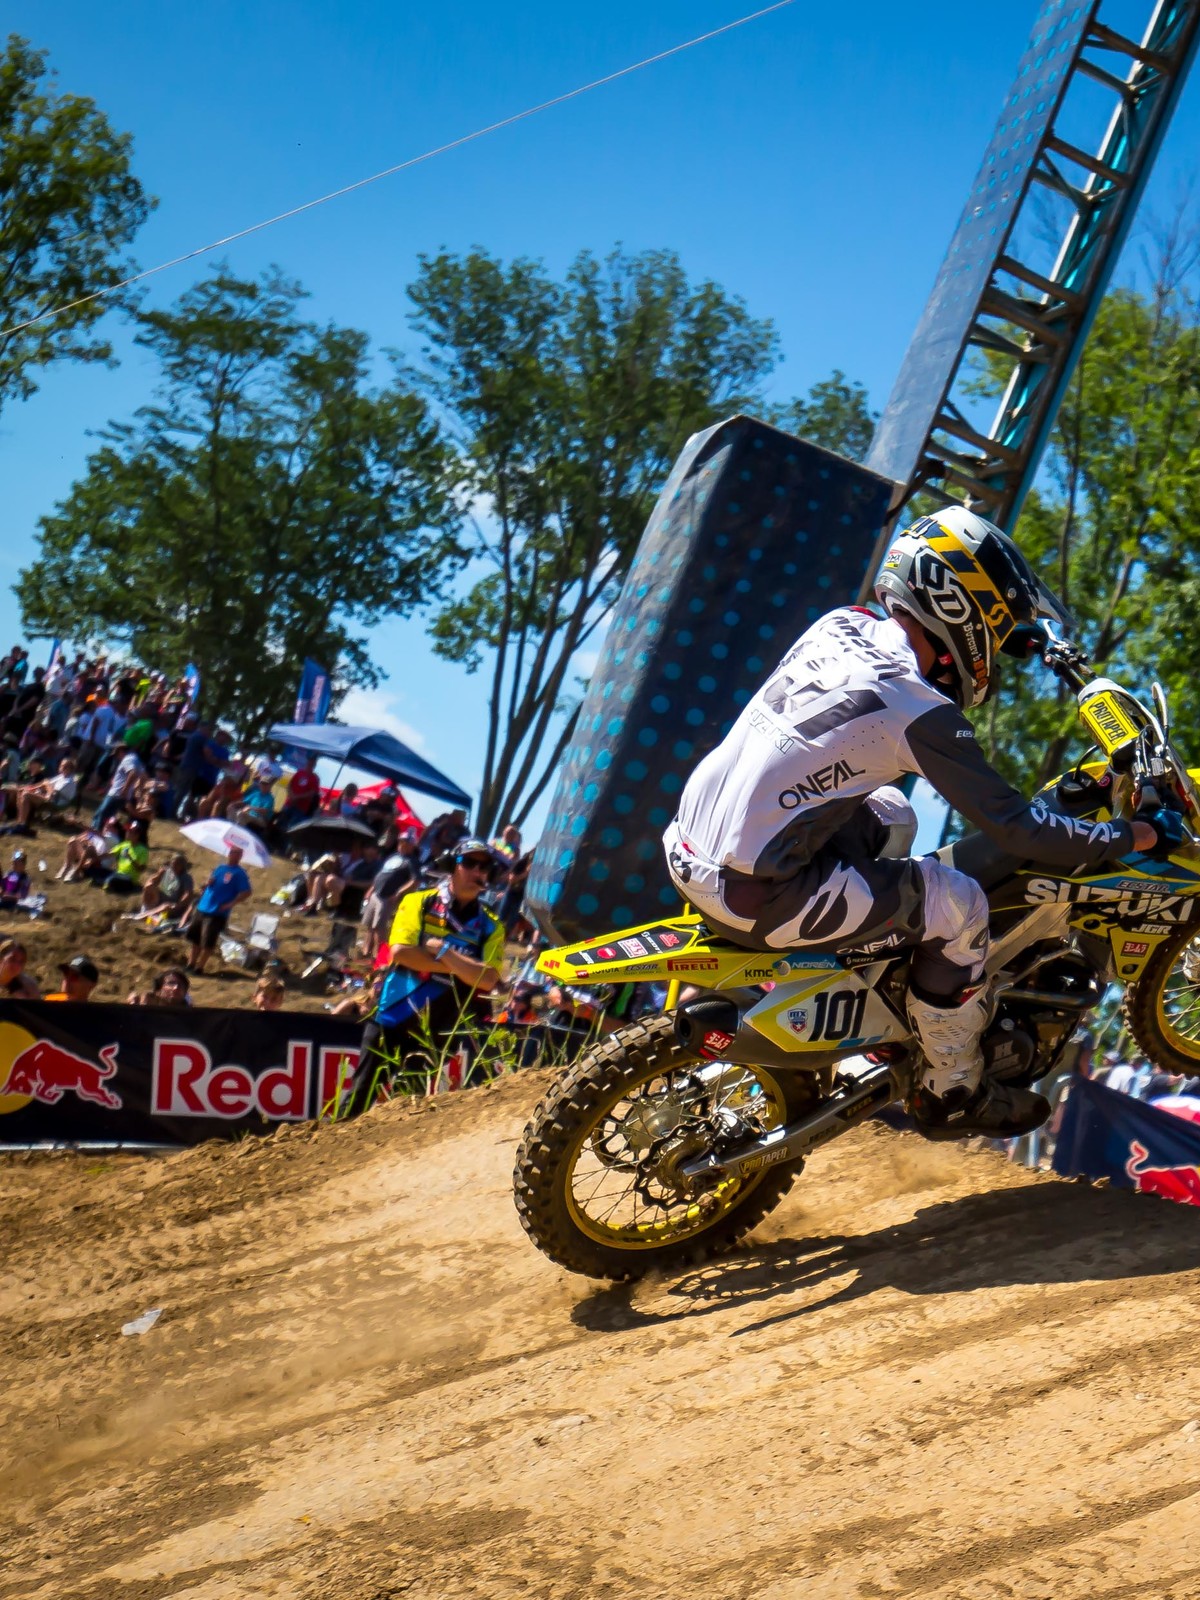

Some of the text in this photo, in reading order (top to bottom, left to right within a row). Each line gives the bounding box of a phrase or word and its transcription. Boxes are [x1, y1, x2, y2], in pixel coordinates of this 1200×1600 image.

[1024, 878, 1194, 922] SUZUKI
[1130, 924, 1172, 935] JGR
[667, 957, 719, 972] PIRELLI
[808, 987, 869, 1043] 101
[151, 1037, 312, 1120] Red
